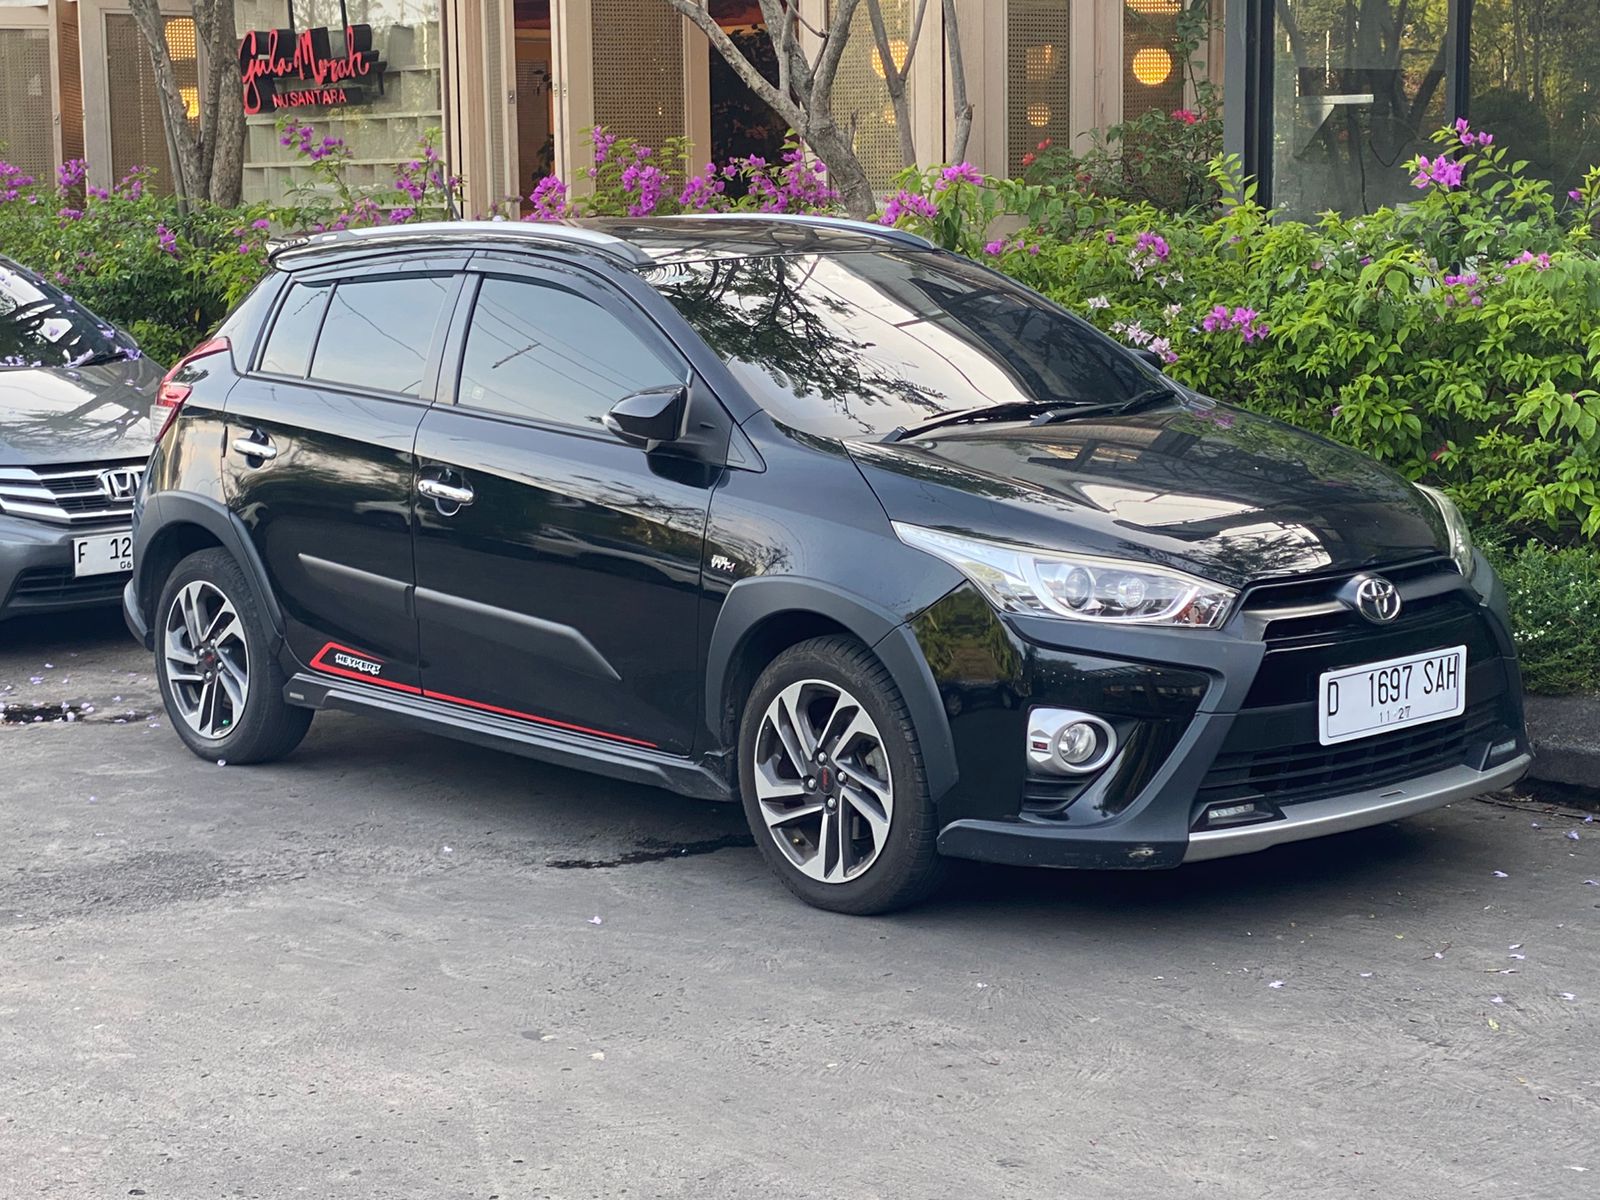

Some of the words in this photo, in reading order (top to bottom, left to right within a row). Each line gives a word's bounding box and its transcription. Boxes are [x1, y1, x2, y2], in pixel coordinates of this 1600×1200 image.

[239, 30, 292, 114] Gula
[272, 89, 347, 108] NUSANTARA
[78, 541, 88, 563] F
[1328, 681, 1339, 717] D
[1368, 665, 1413, 707] 1697
[1423, 656, 1458, 695] SAH
